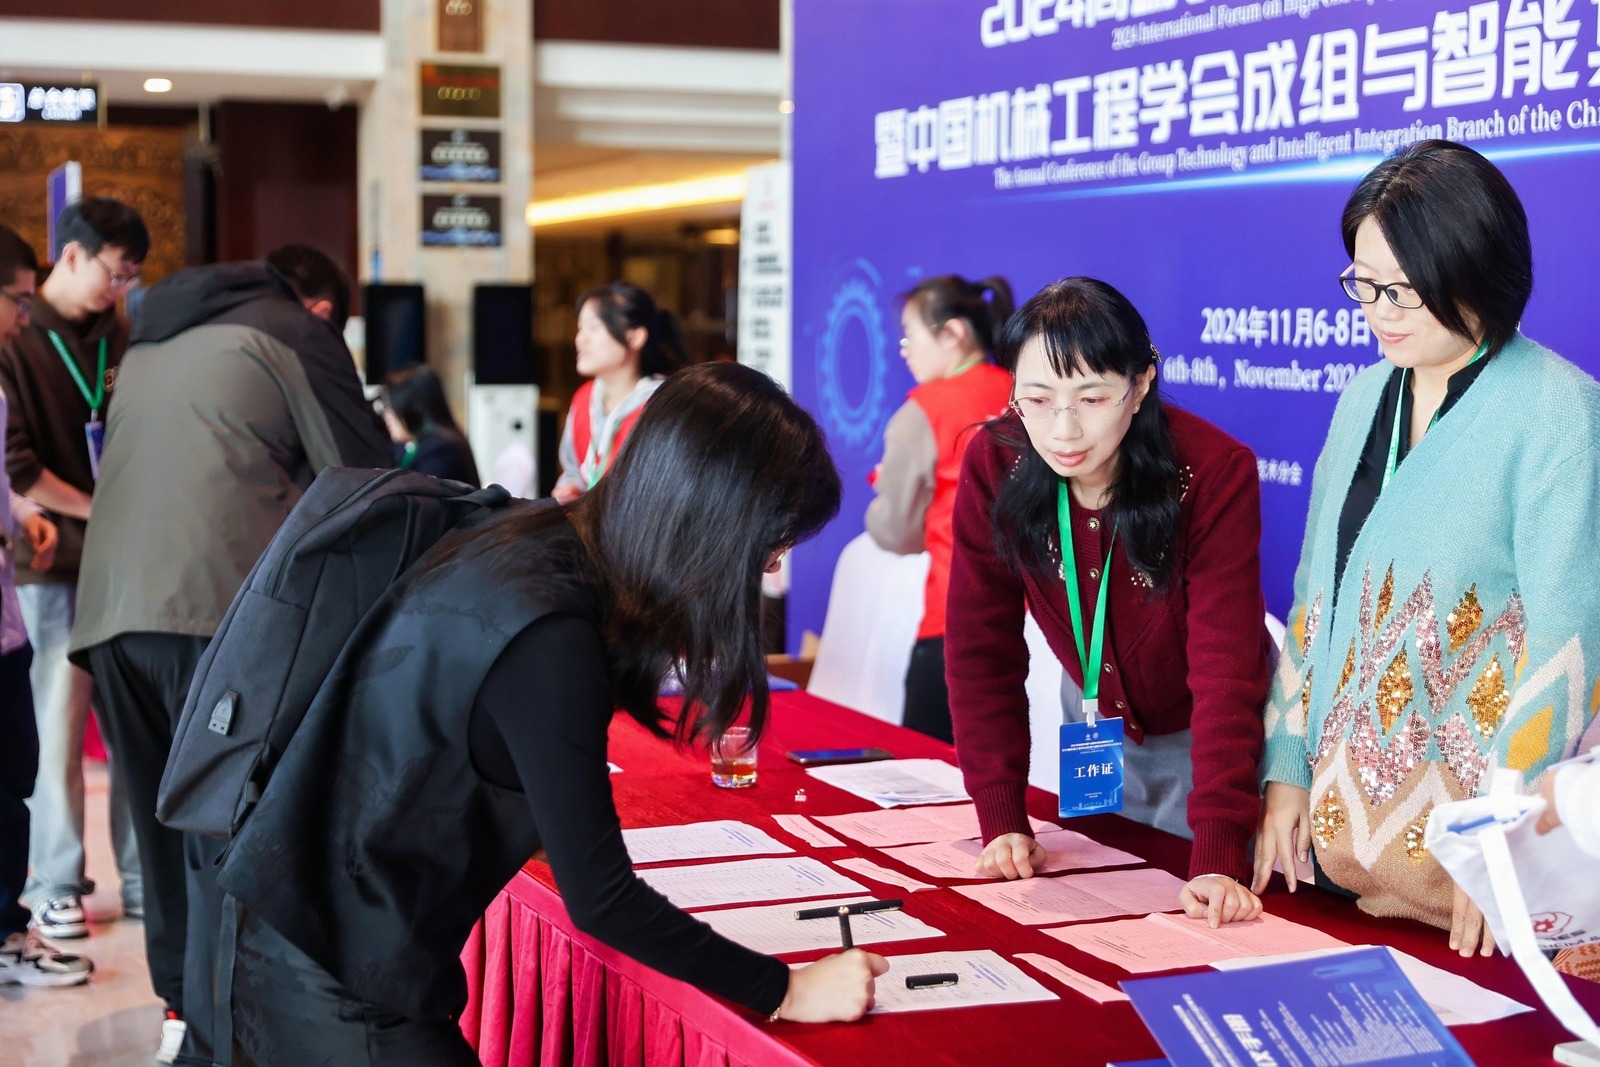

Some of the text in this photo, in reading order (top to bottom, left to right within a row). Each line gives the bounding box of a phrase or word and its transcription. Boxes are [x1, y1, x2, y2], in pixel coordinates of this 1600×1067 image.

[1138, 5, 1217, 47] International
[1218, 3, 1262, 29] Forum
[1262, 0, 1282, 20] on
[874, 0, 1600, 179] 暨中国机械工程学会成组与智能
[1176, 141, 1249, 172] Technology
[1249, 136, 1277, 164] and
[1277, 125, 1352, 162] Intelligent
[1354, 119, 1443, 154] Integration
[1446, 108, 1505, 142] Branch
[1508, 104, 1529, 136] of
[1530, 103, 1562, 133] the
[1200, 305, 1371, 348] 2024年11月6-8日
[1233, 359, 1322, 392] November
[1323, 363, 1366, 393] 202
[1073, 762, 1114, 779] 工作证
